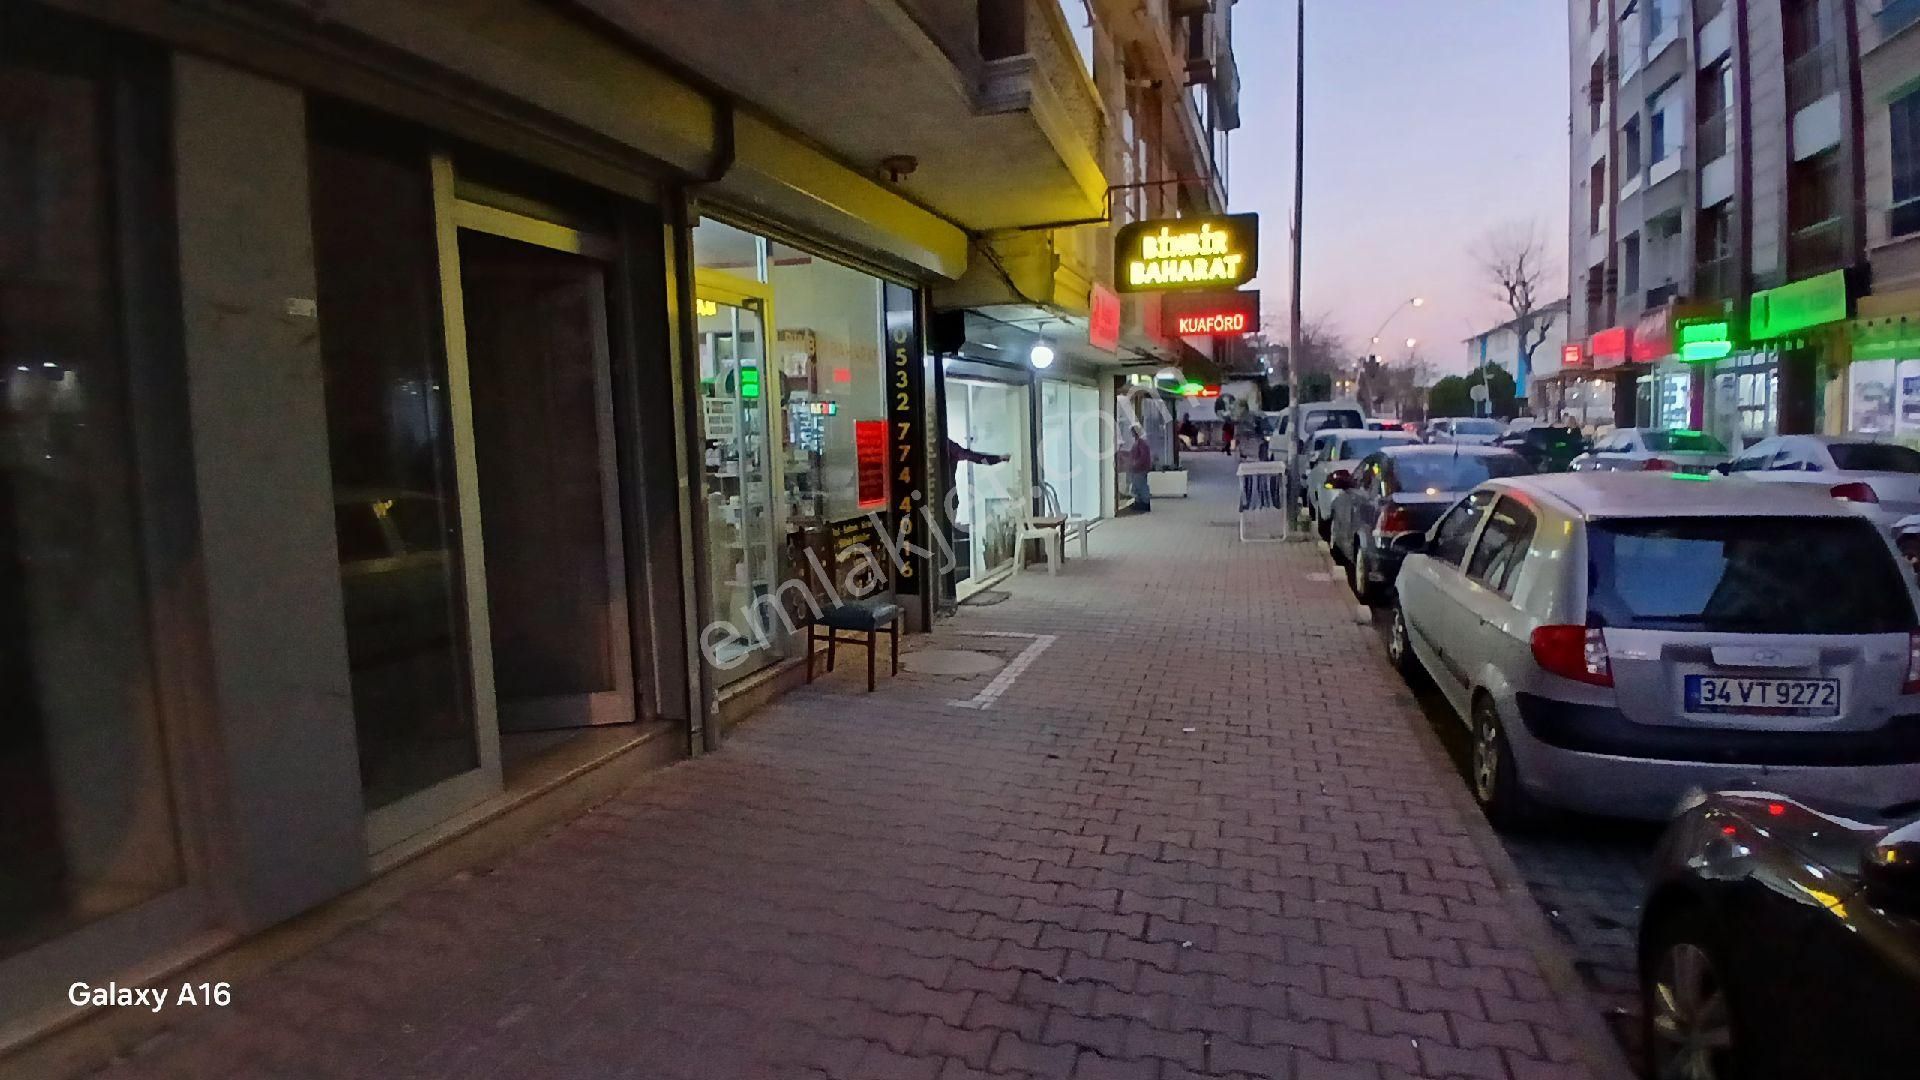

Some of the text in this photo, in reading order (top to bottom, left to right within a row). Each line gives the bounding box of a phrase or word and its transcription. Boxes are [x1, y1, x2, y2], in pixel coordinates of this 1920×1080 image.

[1129, 254, 1242, 286] BAHARAT
[1179, 314, 1244, 334] KUAFÖRÜ
[893, 326, 911, 411] 0532
[896, 422, 912, 484] 774
[1702, 680, 1836, 706] 34 VT 9272
